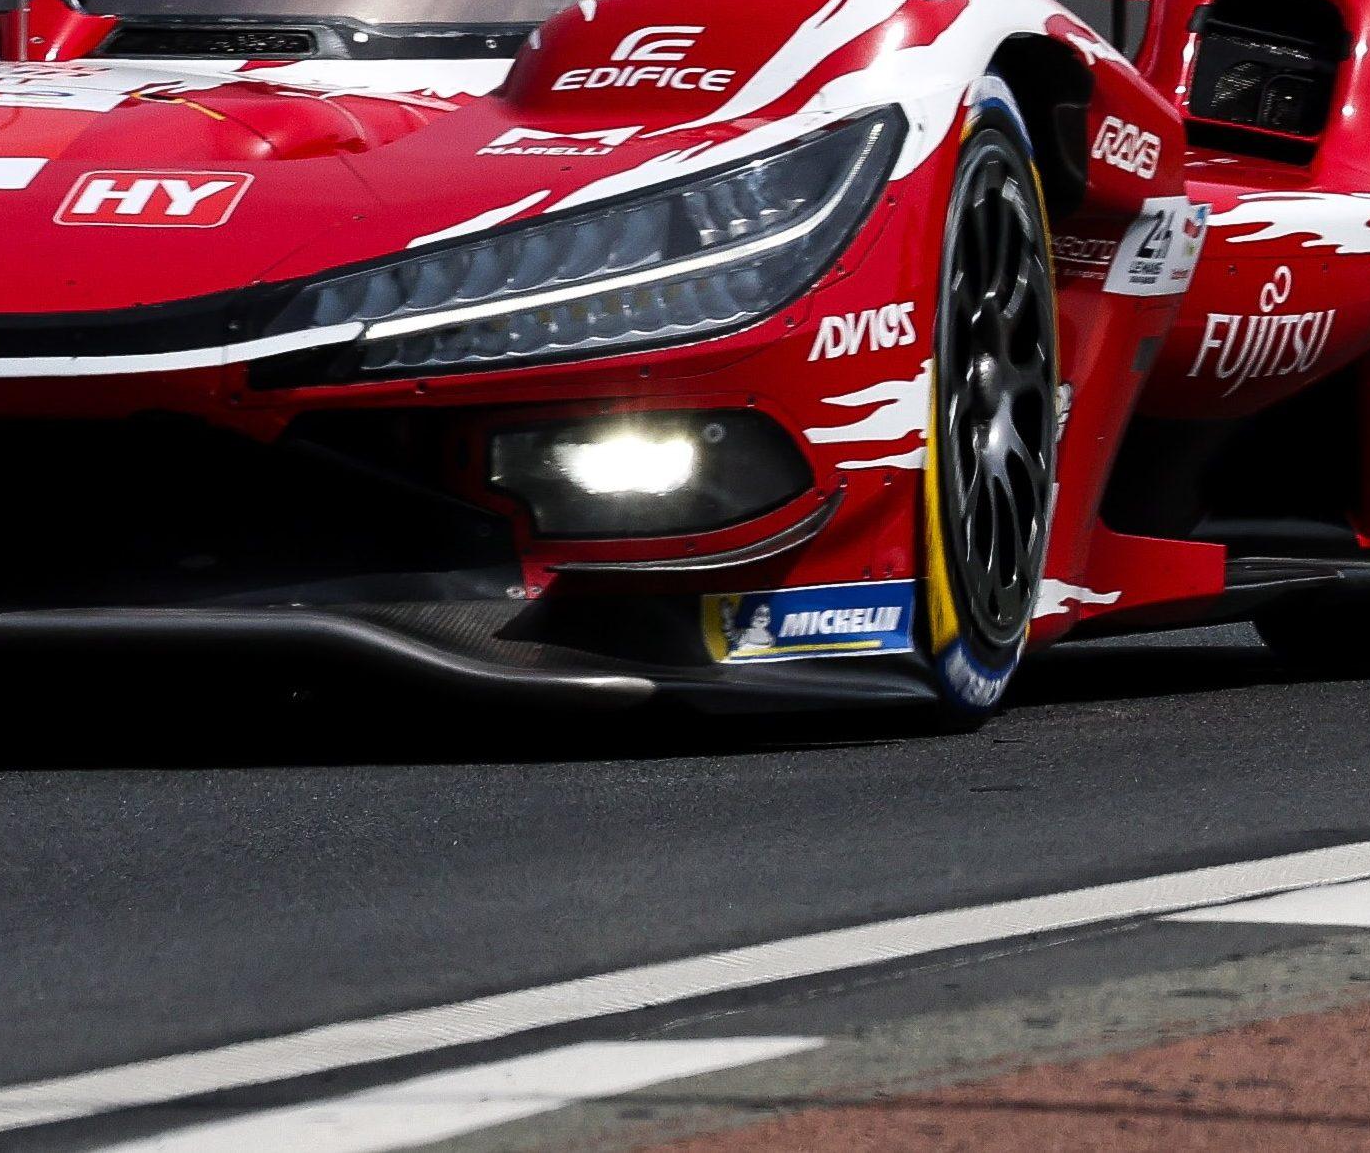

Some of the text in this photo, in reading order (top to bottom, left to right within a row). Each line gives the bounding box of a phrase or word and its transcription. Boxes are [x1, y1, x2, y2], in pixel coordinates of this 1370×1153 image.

[551, 66, 736, 92] EDIFICE
[476, 146, 615, 156] MARELLI
[72, 171, 239, 216] HY
[1186, 309, 1337, 398] FUJITSU
[778, 606, 903, 638] MICHELIN
